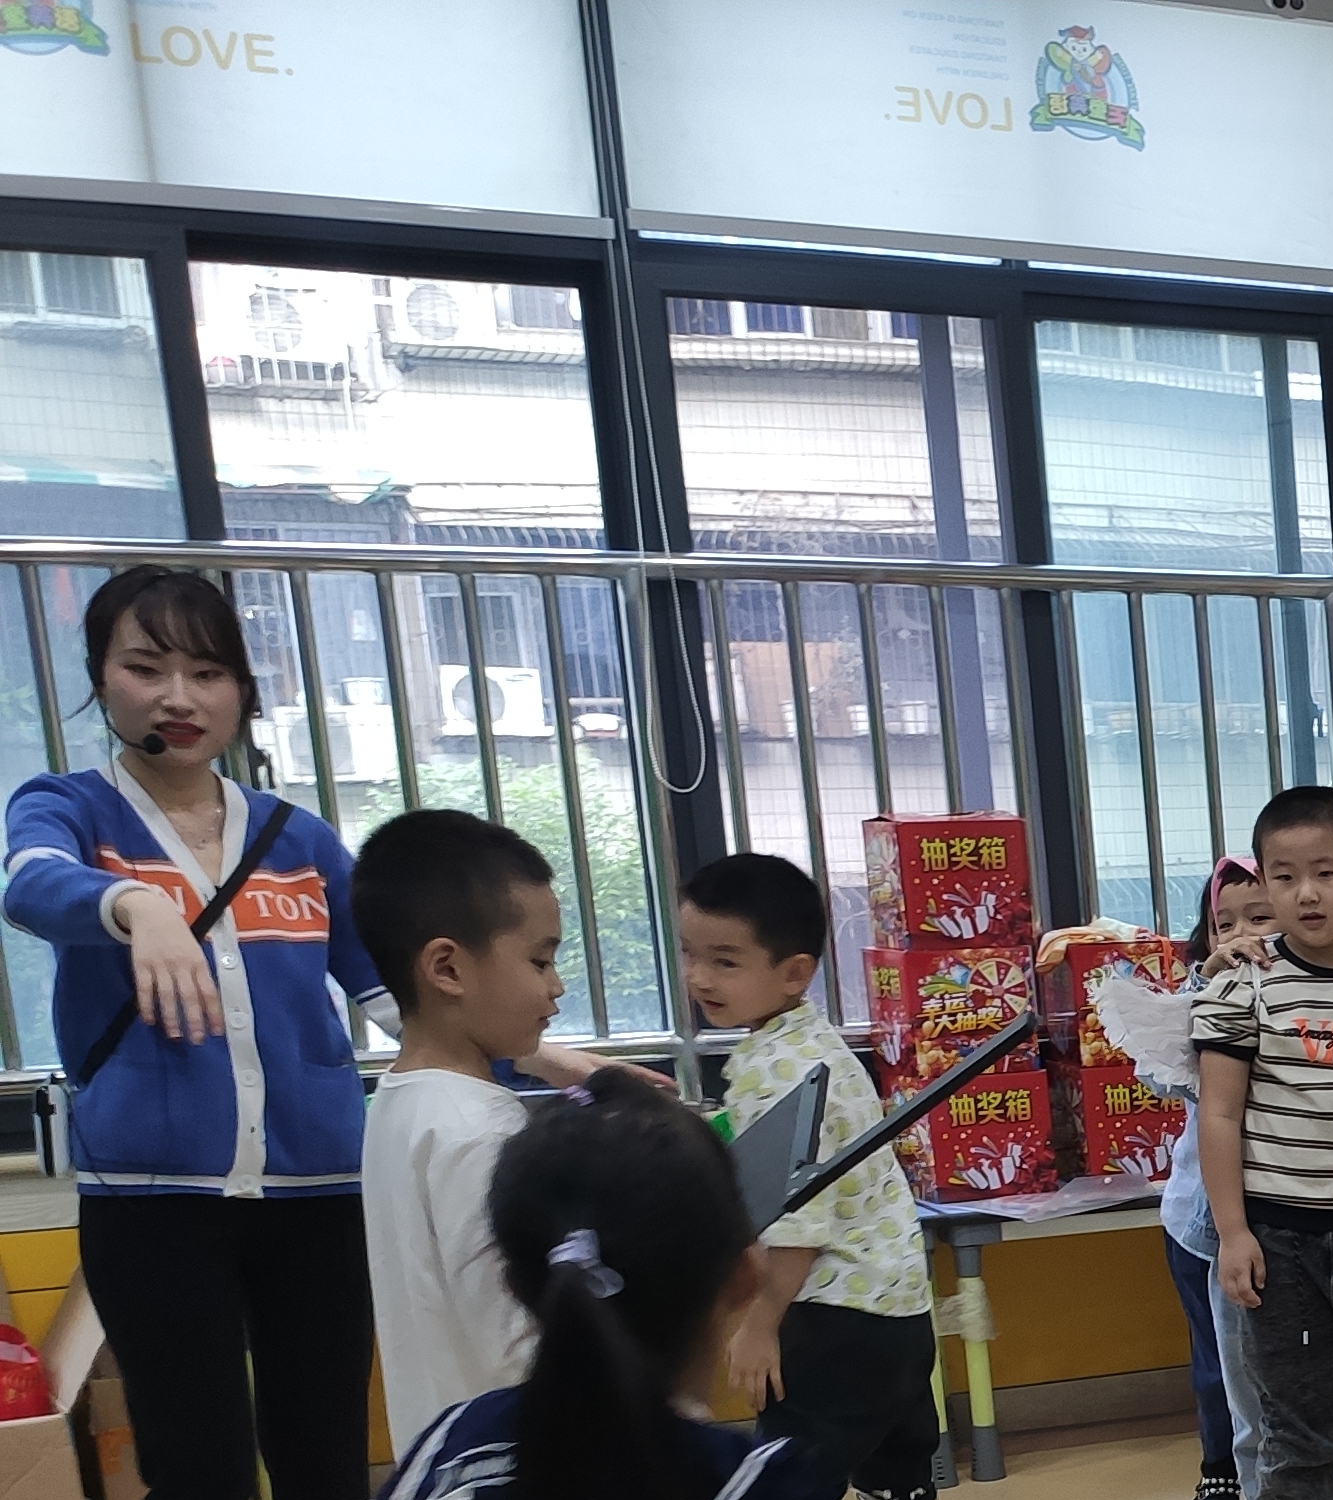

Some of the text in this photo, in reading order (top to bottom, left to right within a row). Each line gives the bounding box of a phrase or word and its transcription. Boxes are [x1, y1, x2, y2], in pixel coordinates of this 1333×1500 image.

[128, 21, 294, 76] LOVE.
[920, 836, 1007, 872] 抽奖箱
[916, 993, 975, 1026] 幸运
[930, 1007, 1003, 1038] 大抽奖
[948, 1089, 1032, 1127] 抽奖箱
